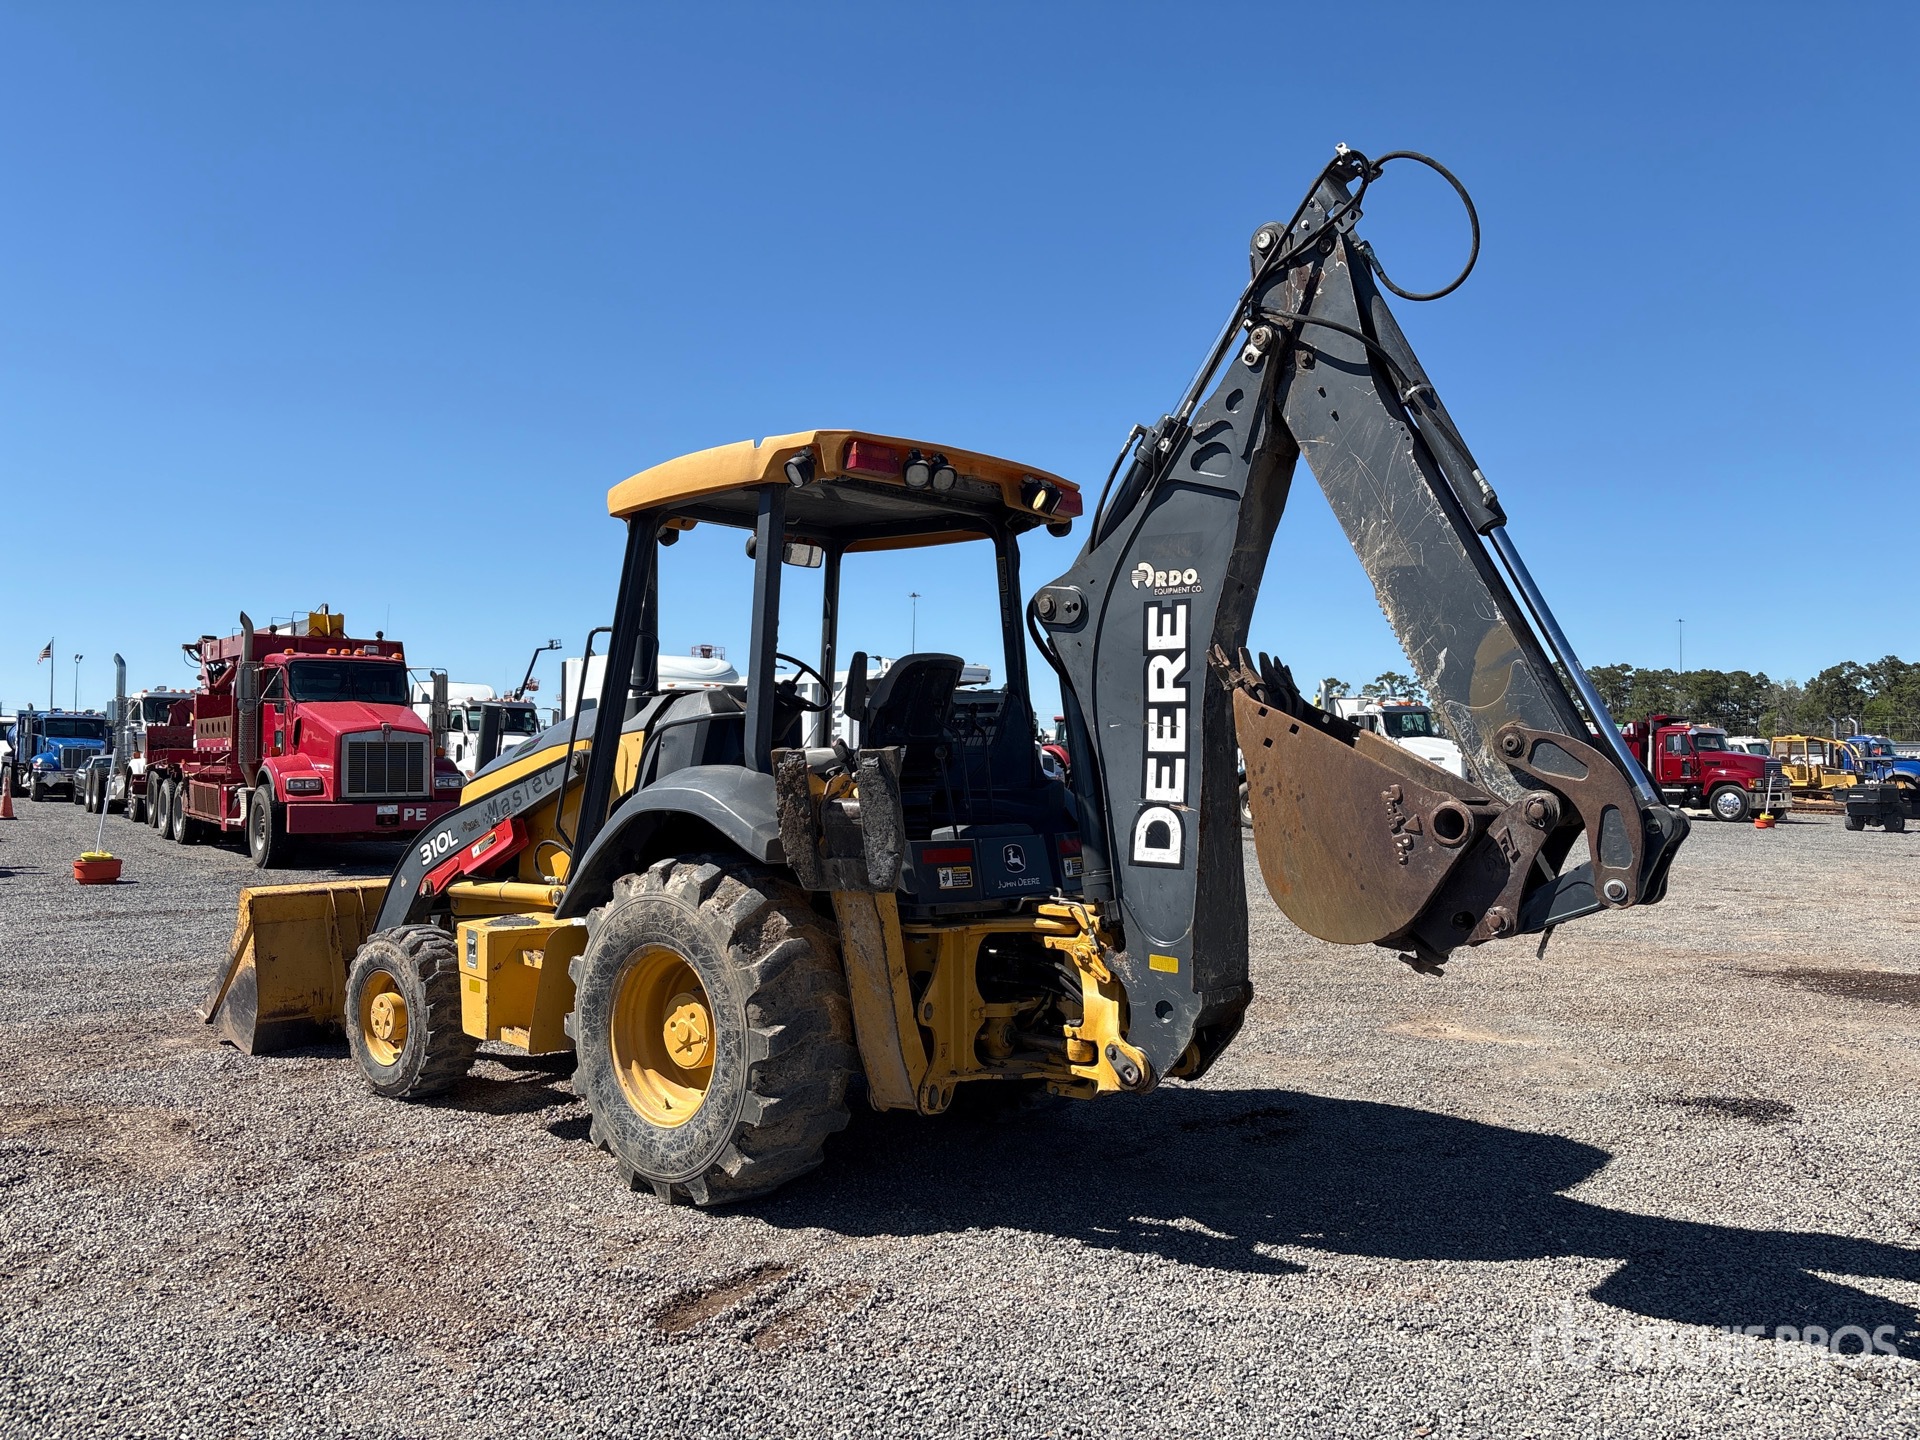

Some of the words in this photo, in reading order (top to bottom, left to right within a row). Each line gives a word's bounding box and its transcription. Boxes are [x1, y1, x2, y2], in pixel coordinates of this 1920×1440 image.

[1154, 586, 1190, 596] EQUIPMENT
[1134, 604, 1188, 865] DEERE
[403, 808, 427, 821] PE
[419, 828, 459, 867] 310L
[997, 879, 1017, 889] JOHN
[1017, 877, 1041, 887] DEERE
